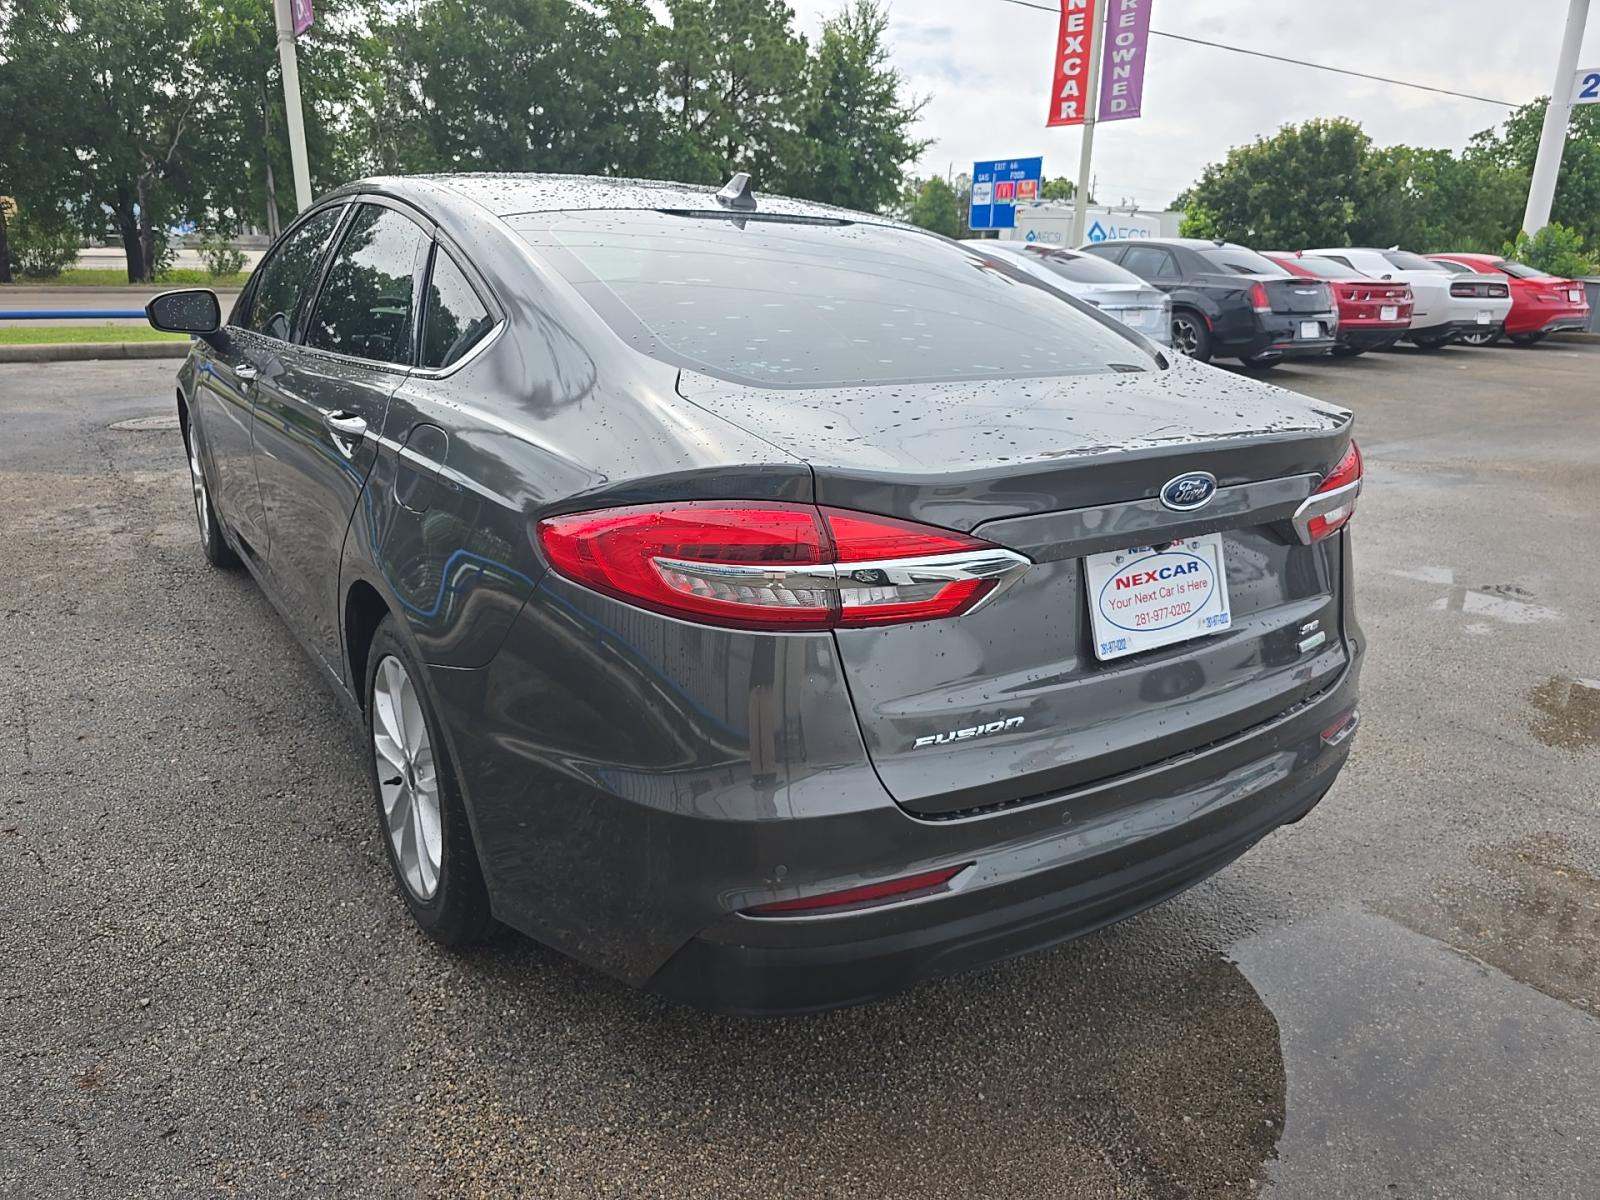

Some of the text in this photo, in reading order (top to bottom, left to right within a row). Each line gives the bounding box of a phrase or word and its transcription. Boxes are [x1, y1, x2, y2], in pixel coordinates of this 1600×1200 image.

[1060, 0, 1086, 119] NEXCAR
[1579, 73, 1600, 98] 2
[1115, 561, 1199, 590] NEXCAR
[1109, 597, 1132, 611] Your
[1135, 591, 1157, 604] Next
[1160, 586, 1175, 598] Car
[1187, 579, 1208, 592] Here
[1135, 602, 1192, 626] 281-977-0202
